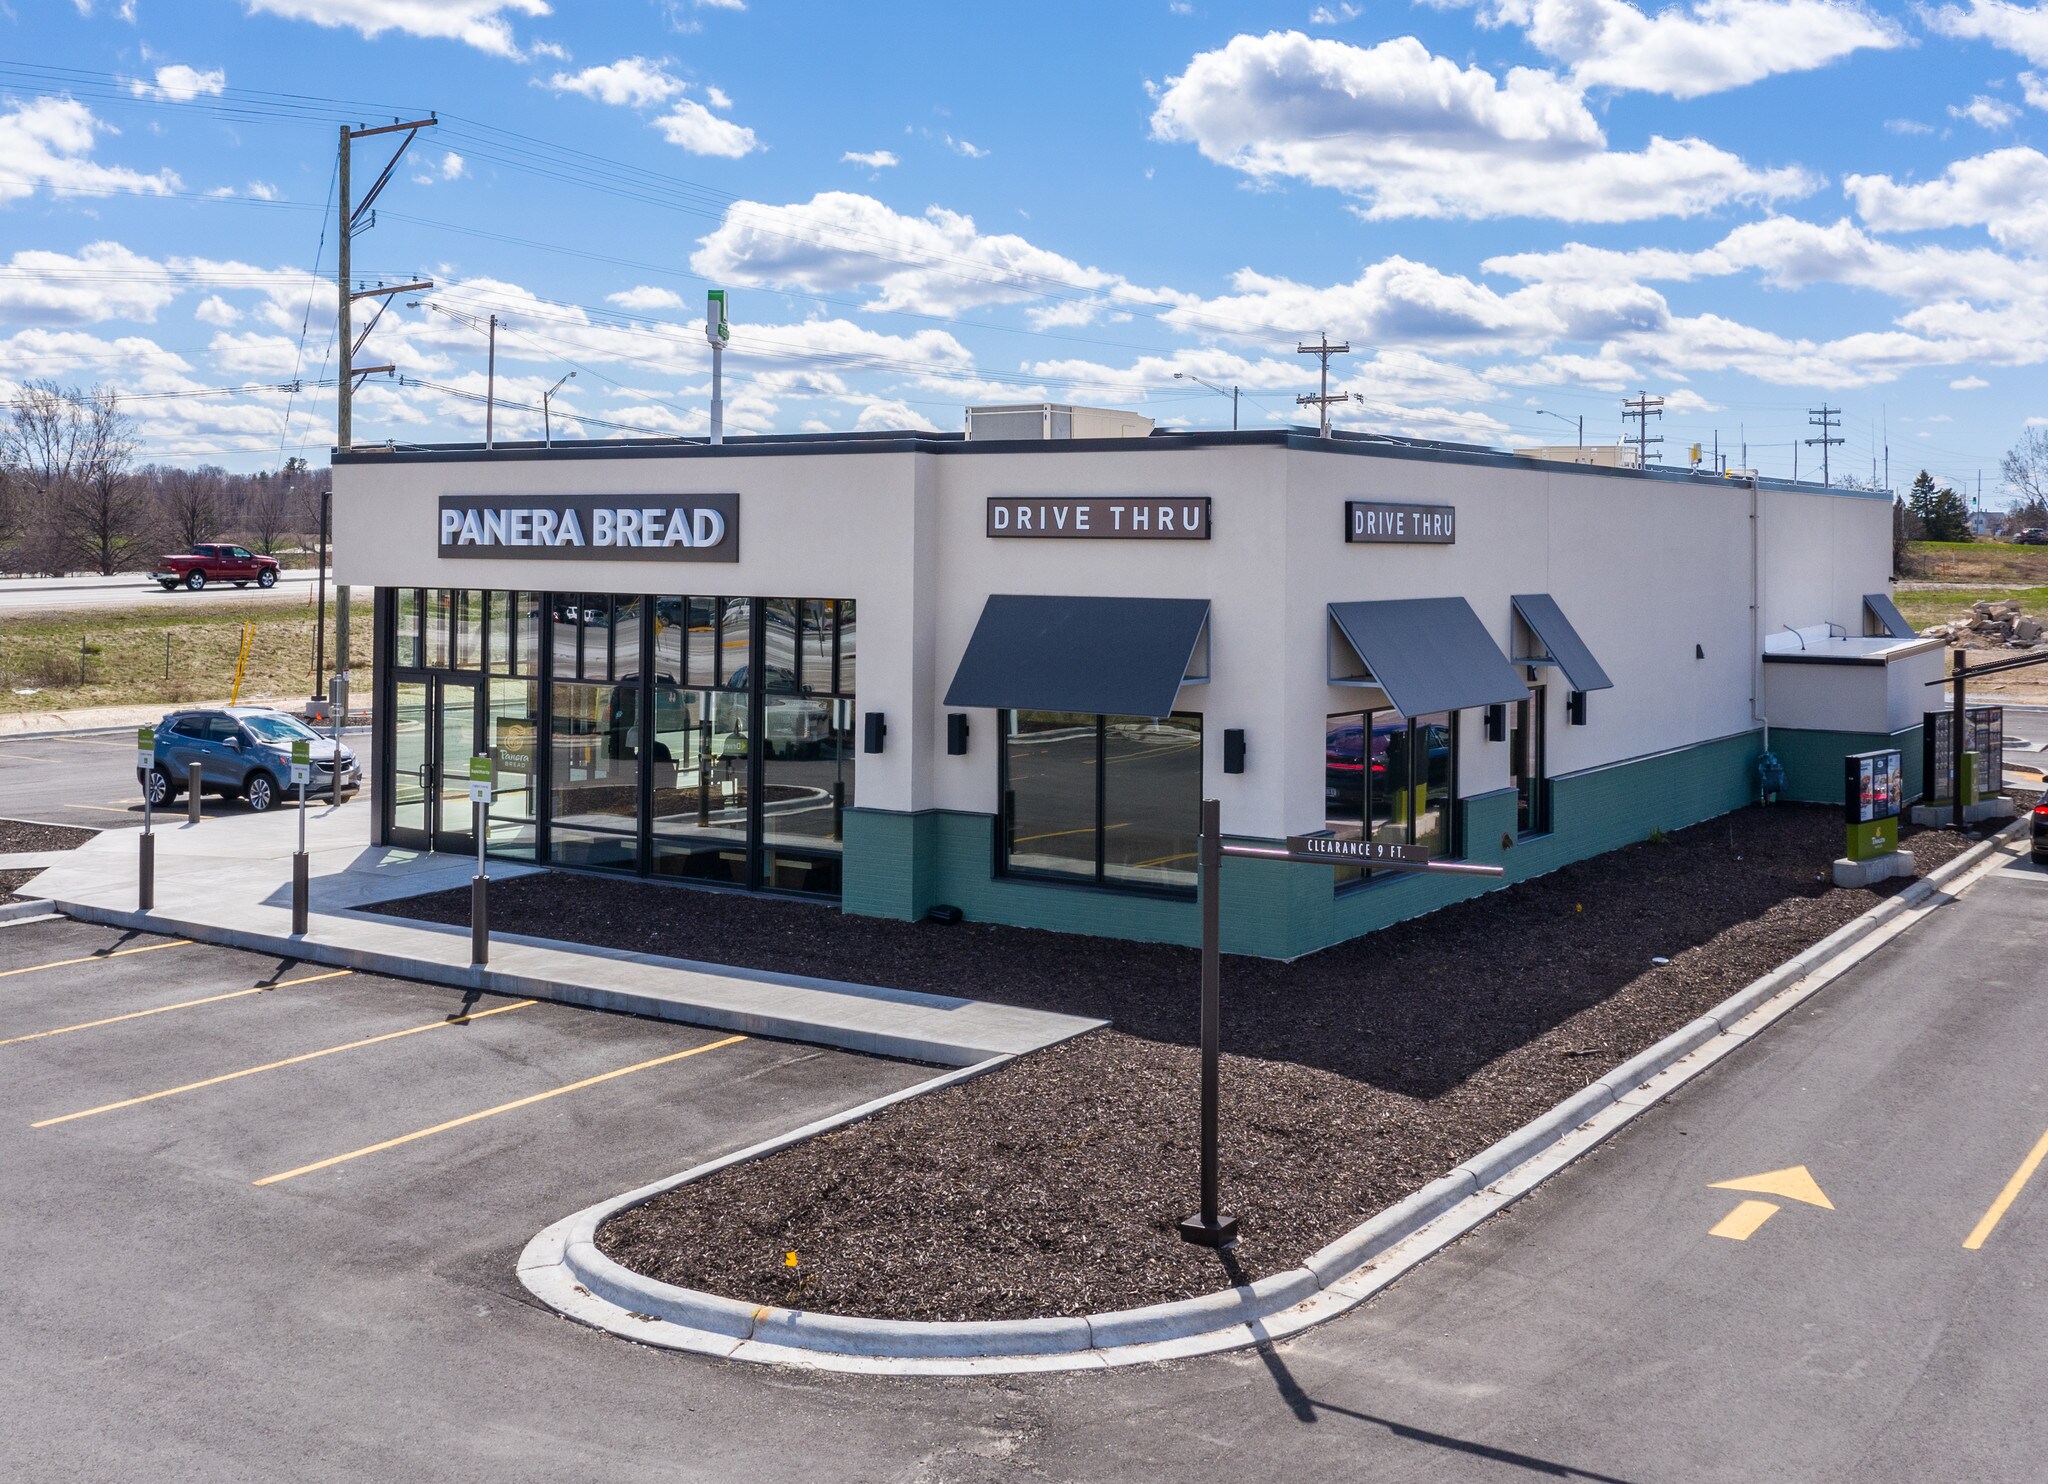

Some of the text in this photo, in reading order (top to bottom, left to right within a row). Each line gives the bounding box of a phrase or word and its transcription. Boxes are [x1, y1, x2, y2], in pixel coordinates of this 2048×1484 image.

[441, 508, 725, 548] PANERA BREAD
[993, 506, 1200, 531] DRIVE THRU
[1355, 510, 1452, 536] DRIVE THRU
[499, 749, 529, 762] Panera
[1307, 839, 1406, 859] CLEARANCE 9 FT.
